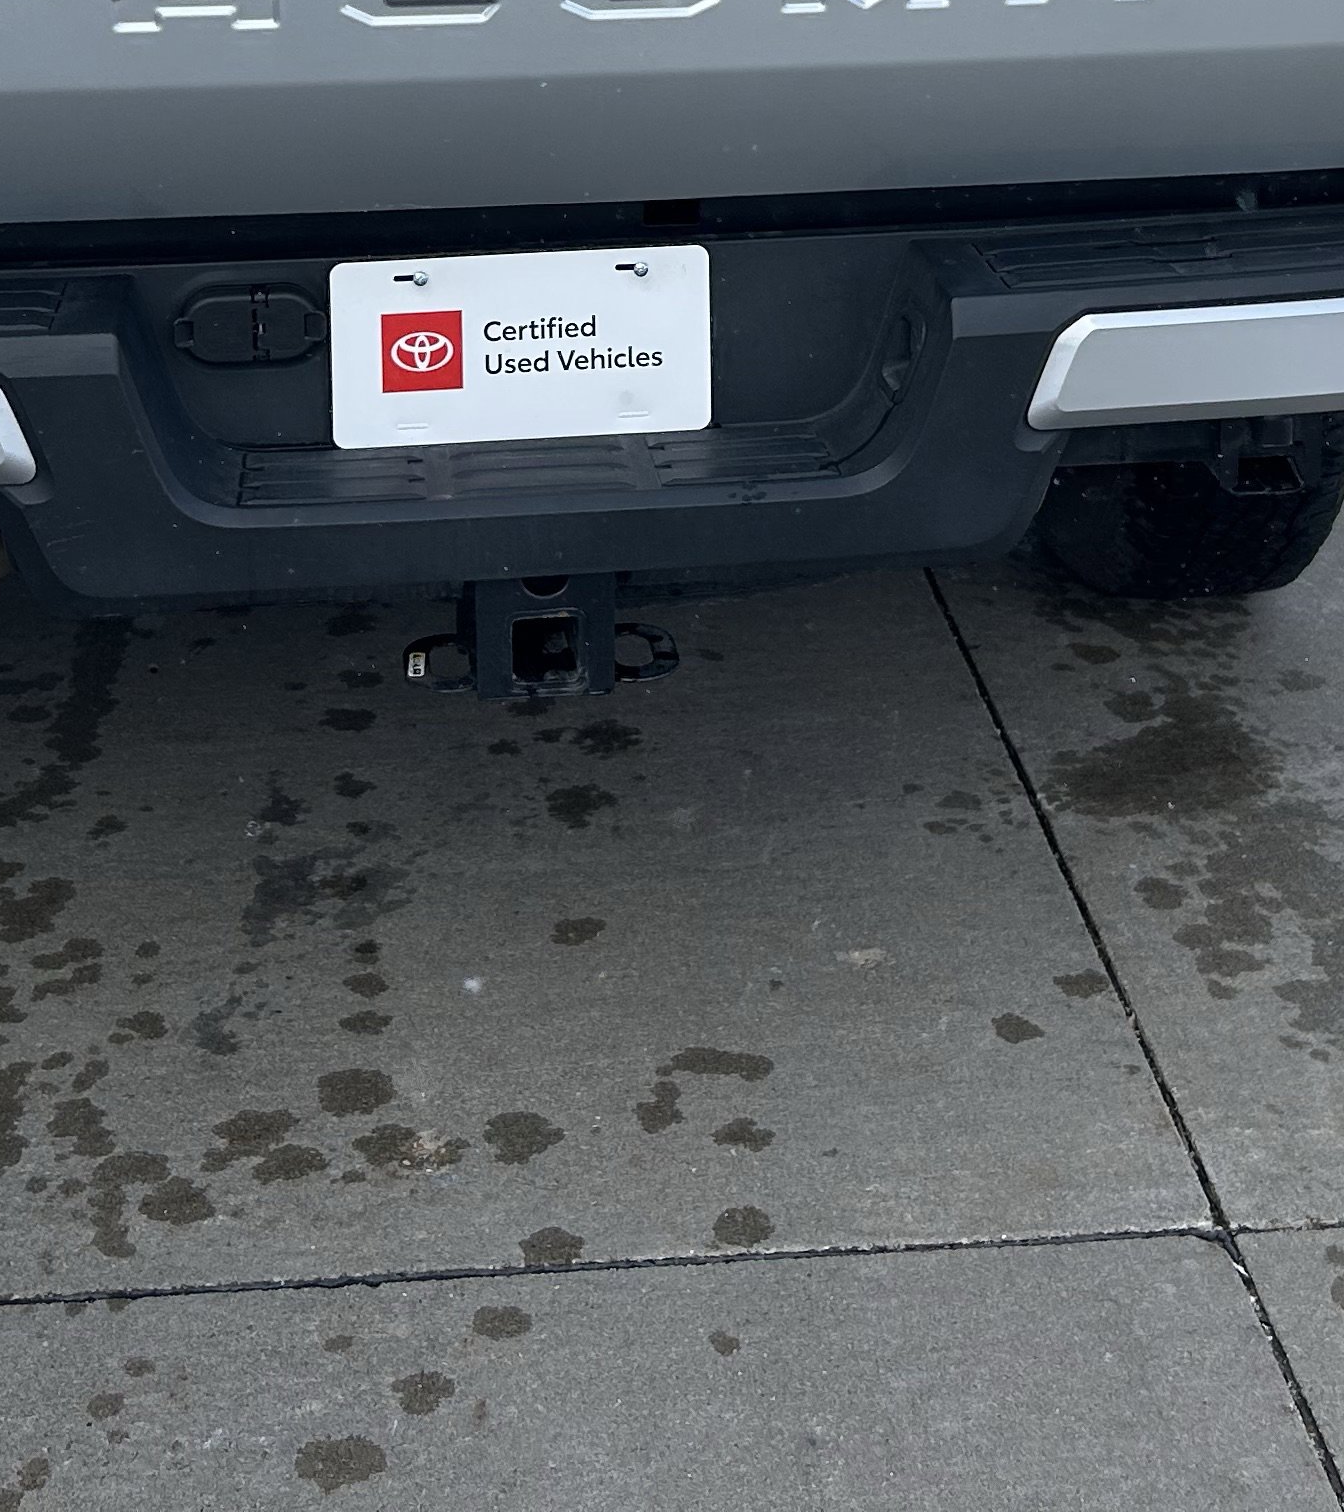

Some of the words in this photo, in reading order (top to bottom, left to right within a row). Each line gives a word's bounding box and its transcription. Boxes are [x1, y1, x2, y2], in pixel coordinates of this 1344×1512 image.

[483, 314, 597, 342] Certified
[485, 349, 549, 375] Used
[556, 345, 663, 371] Vehicles
